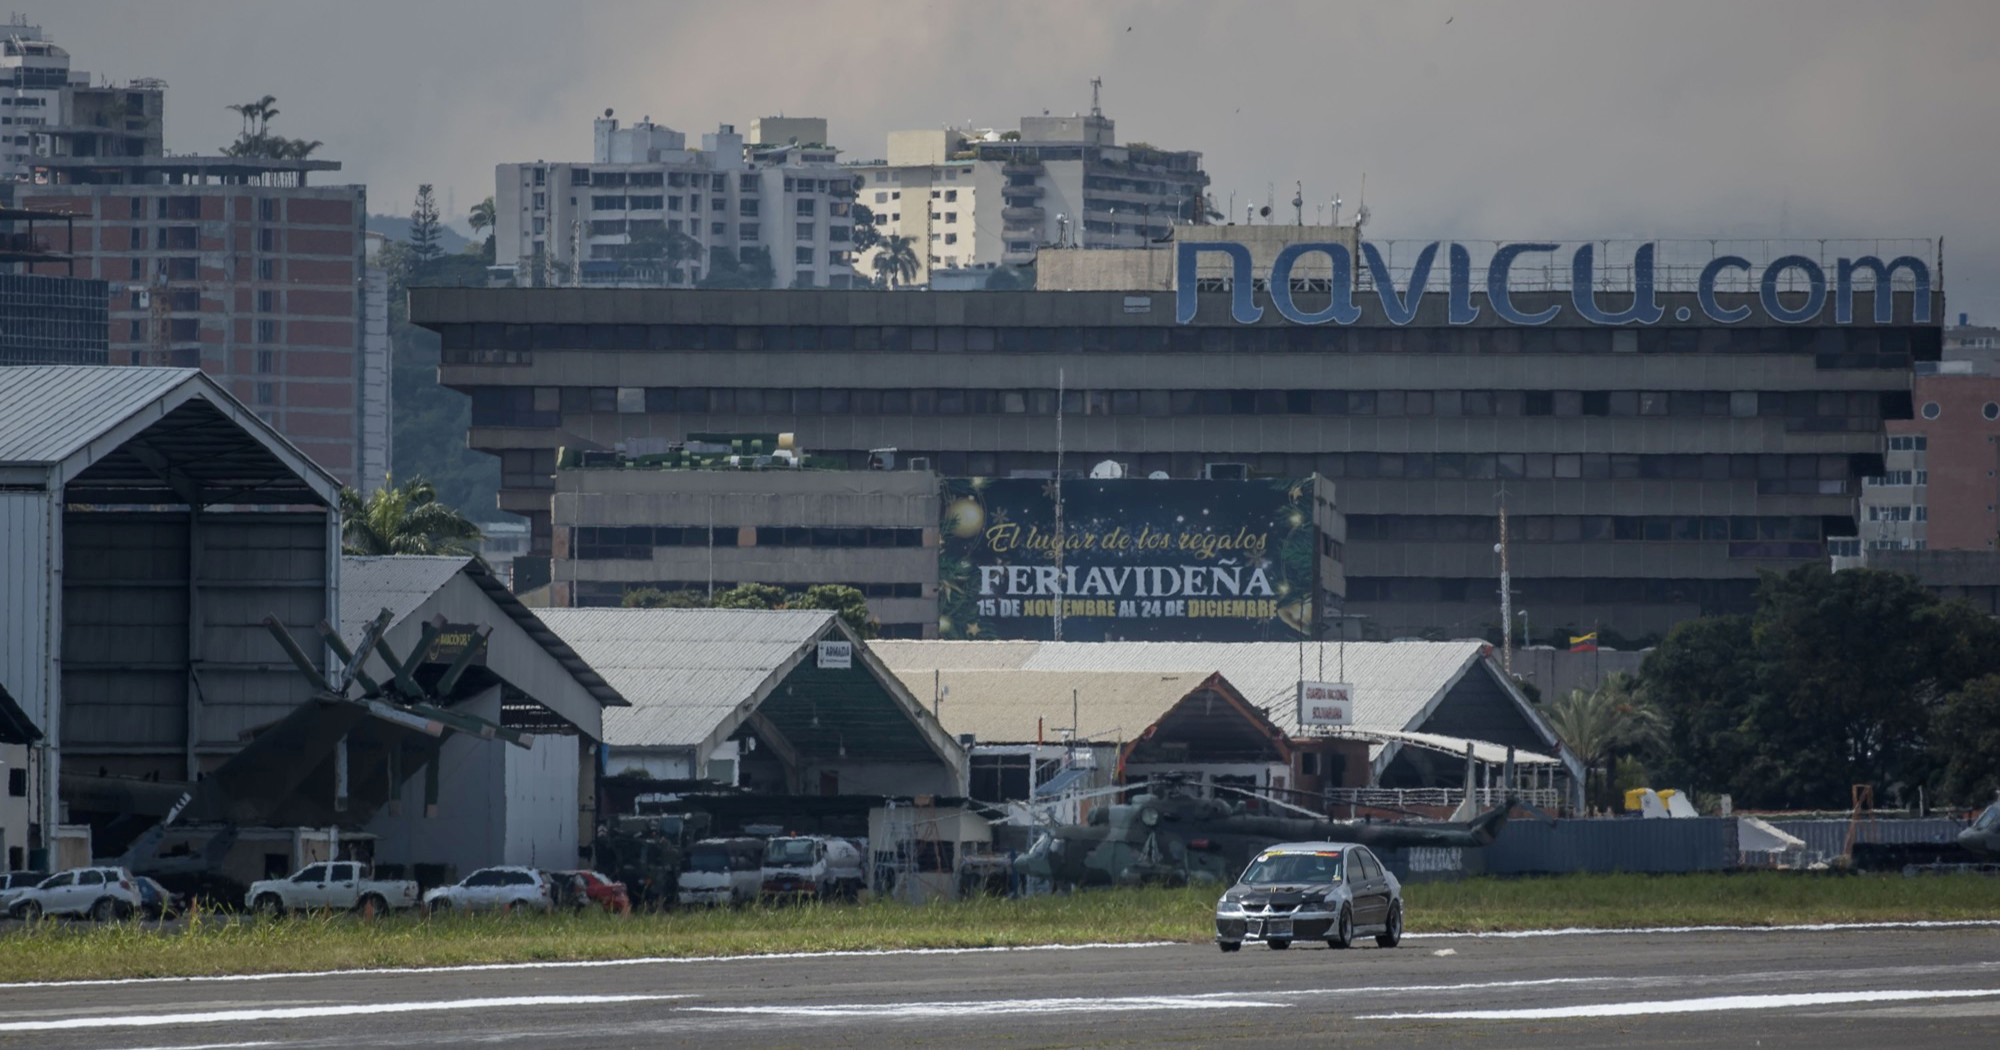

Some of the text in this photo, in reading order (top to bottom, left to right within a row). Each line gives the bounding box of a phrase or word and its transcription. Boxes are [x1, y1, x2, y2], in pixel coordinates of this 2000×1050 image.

[1176, 240, 1932, 326] navicu.com
[986, 523, 1268, 560] El lugar de los regalos
[978, 557, 1275, 597] FERIAVIDEÑA
[977, 600, 1278, 618] 15 DE NOVEMBRE AL 24 DE DICIEMBRE
